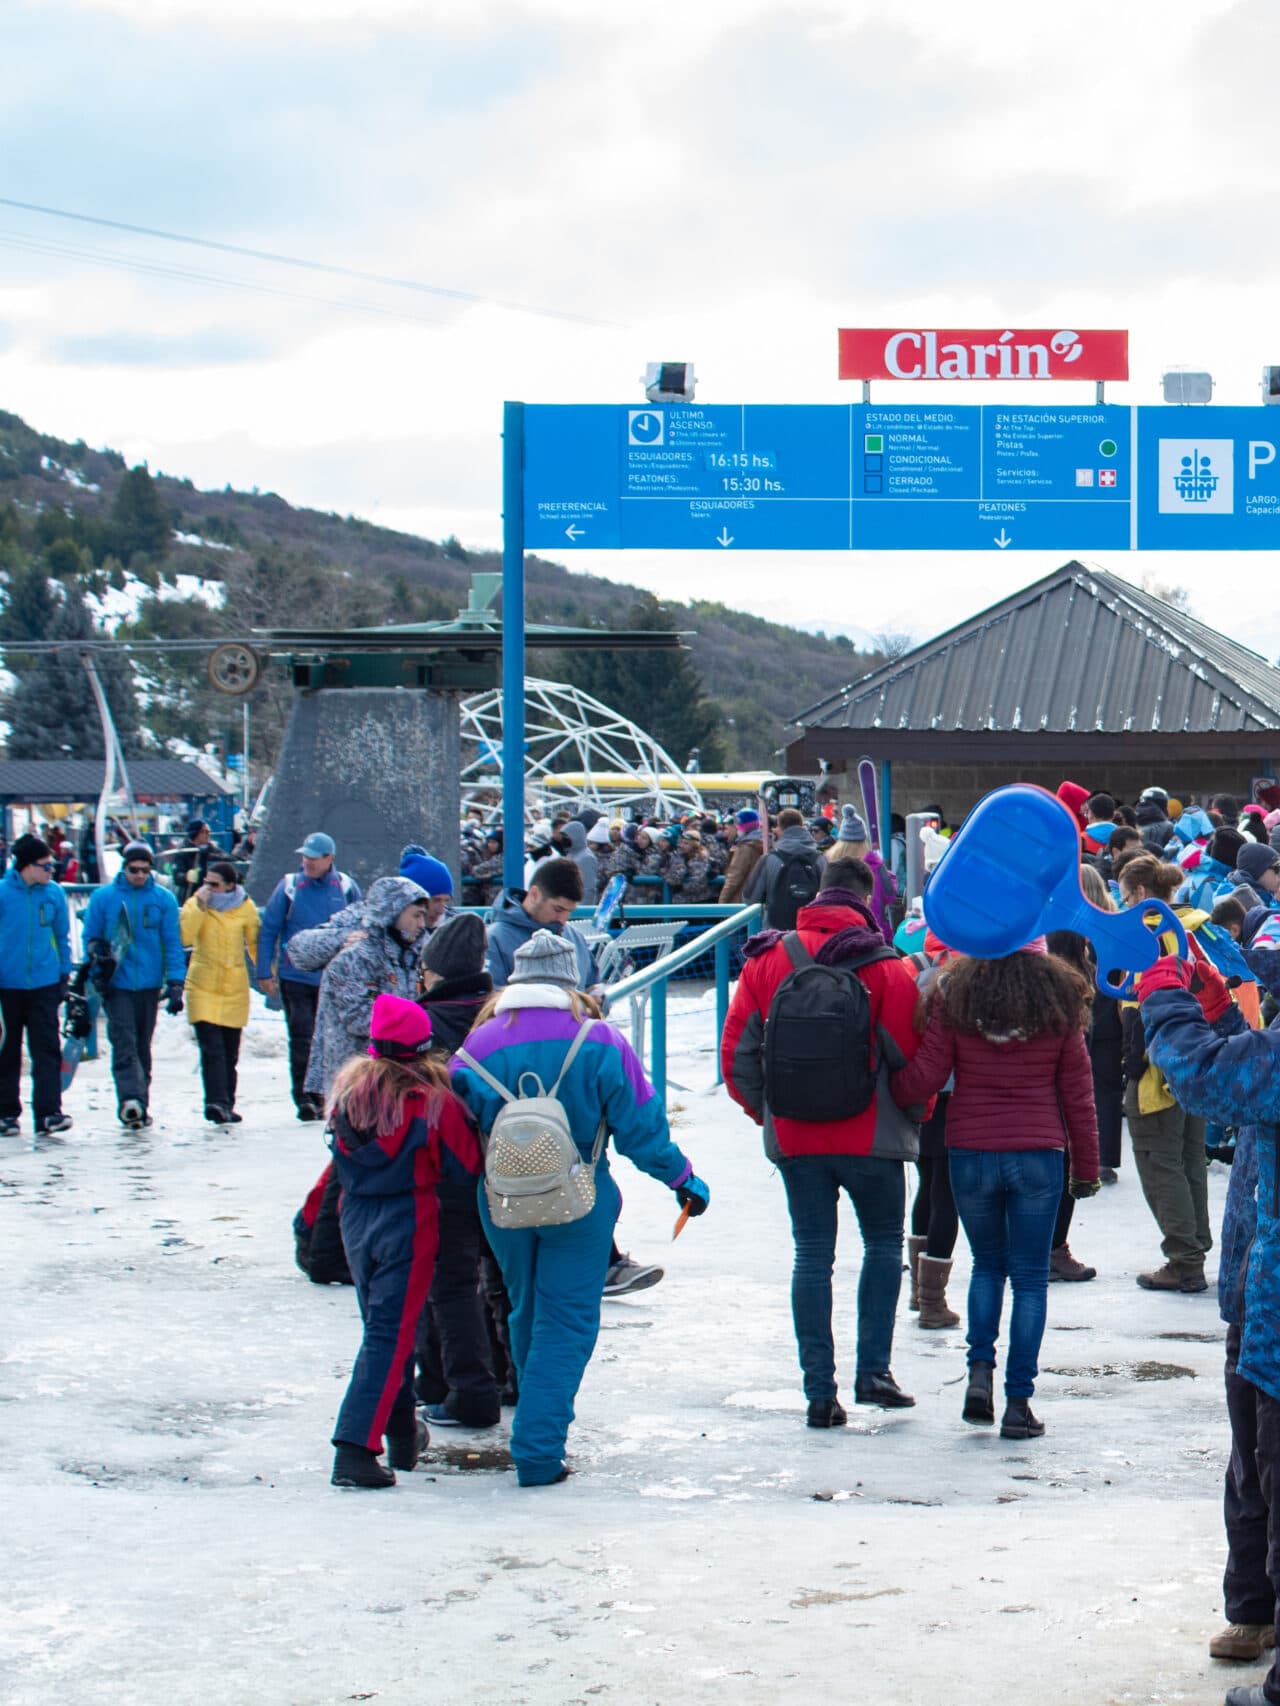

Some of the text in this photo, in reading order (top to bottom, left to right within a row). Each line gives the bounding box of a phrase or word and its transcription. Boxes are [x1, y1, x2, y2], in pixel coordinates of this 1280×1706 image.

[884, 330, 1052, 379] Clarín
[866, 413, 901, 422] ESTADO
[904, 413, 921, 422] DEL
[997, 414, 1010, 423] EN
[1012, 412, 1056, 423] ESTACIÓN
[888, 434, 929, 443] NORMAL
[997, 440, 1023, 449] Pistas
[710, 453, 748, 467] 16:15
[752, 454, 774, 467] hs.
[889, 455, 952, 464] CONDICIONAL
[723, 478, 760, 491] 15:30
[764, 478, 785, 491] hs.
[889, 477, 933, 486] CERRADO
[538, 503, 608, 512] PREFERENCIAL
[689, 501, 755, 510] ESQUIADORES
[978, 503, 1027, 511] PEATONES
